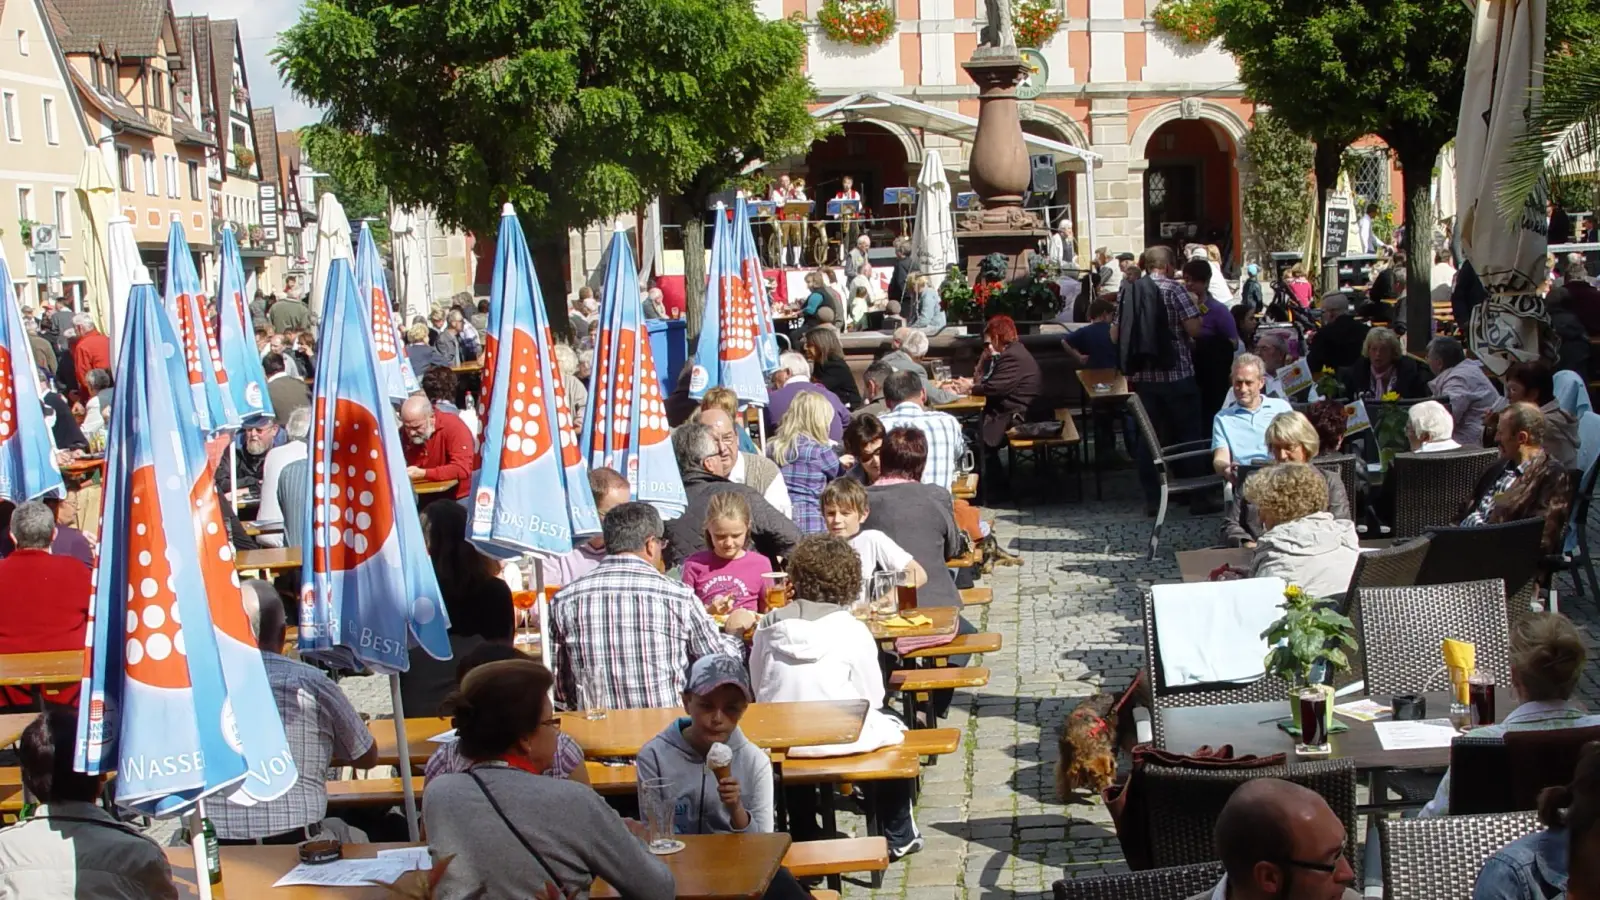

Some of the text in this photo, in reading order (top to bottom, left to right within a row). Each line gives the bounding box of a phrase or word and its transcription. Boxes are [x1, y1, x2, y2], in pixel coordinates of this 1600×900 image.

[651, 481, 673, 493] DAS
[500, 511, 524, 528] DAS
[529, 516, 571, 541] BESTE
[122, 750, 205, 783] WASSE
